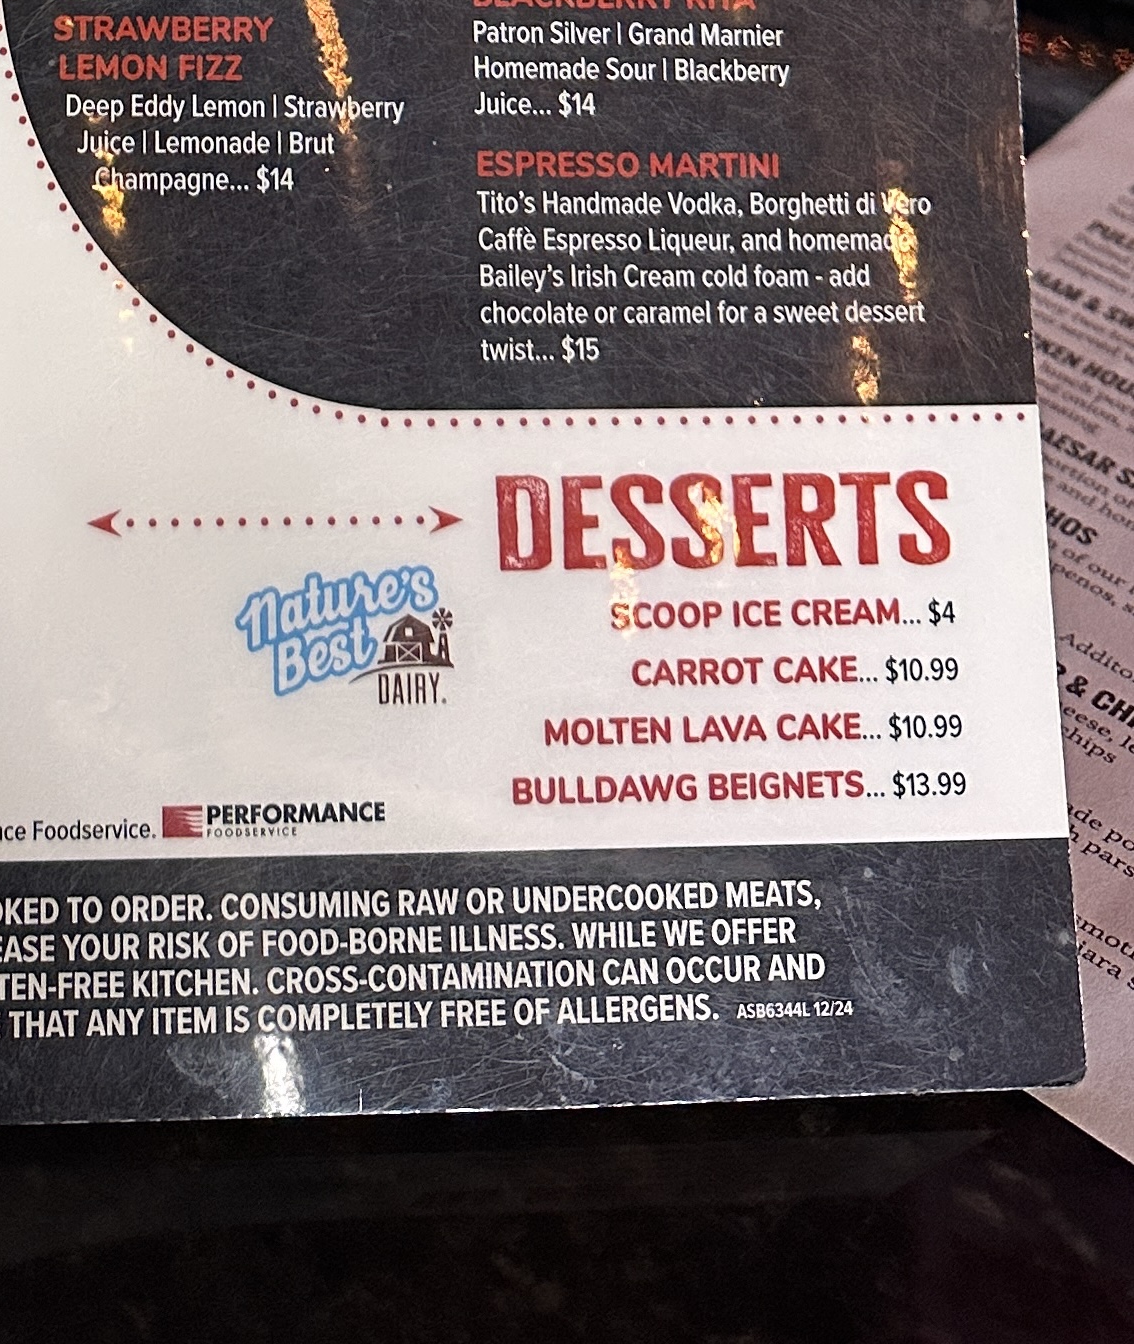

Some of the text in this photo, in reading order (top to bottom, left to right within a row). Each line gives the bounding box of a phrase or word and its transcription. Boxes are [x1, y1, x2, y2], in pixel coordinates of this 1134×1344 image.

[477, 150, 779, 179] ESPRESSO MARTINI
[480, 299, 925, 325] chocolate or caramel for a sweet dessert
[480, 334, 600, 364] twist... $15
[495, 470, 951, 572] DESSERTS
[274, 615, 379, 697] Best
[1065, 674, 1089, 698] &
[512, 770, 966, 806] BULLDAWG BEIGNETS... $13.99
[207, 801, 386, 825] PERFORMANCE
[33, 818, 157, 841] Foodservice.
[207, 826, 298, 838] FOODSERVICE
[8, 1009, 79, 1038] THAT
[86, 1008, 144, 1037] ANY
[153, 1005, 251, 1035] ITEM
[225, 1005, 250, 1033] IS
[257, 1000, 431, 1032] COMPLETELY
[440, 999, 507, 1028] FREE
[514, 999, 551, 1025] OF
[557, 994, 720, 1025] ALLERGENS.
[736, 999, 854, 1020] ASB6344L 12/24
